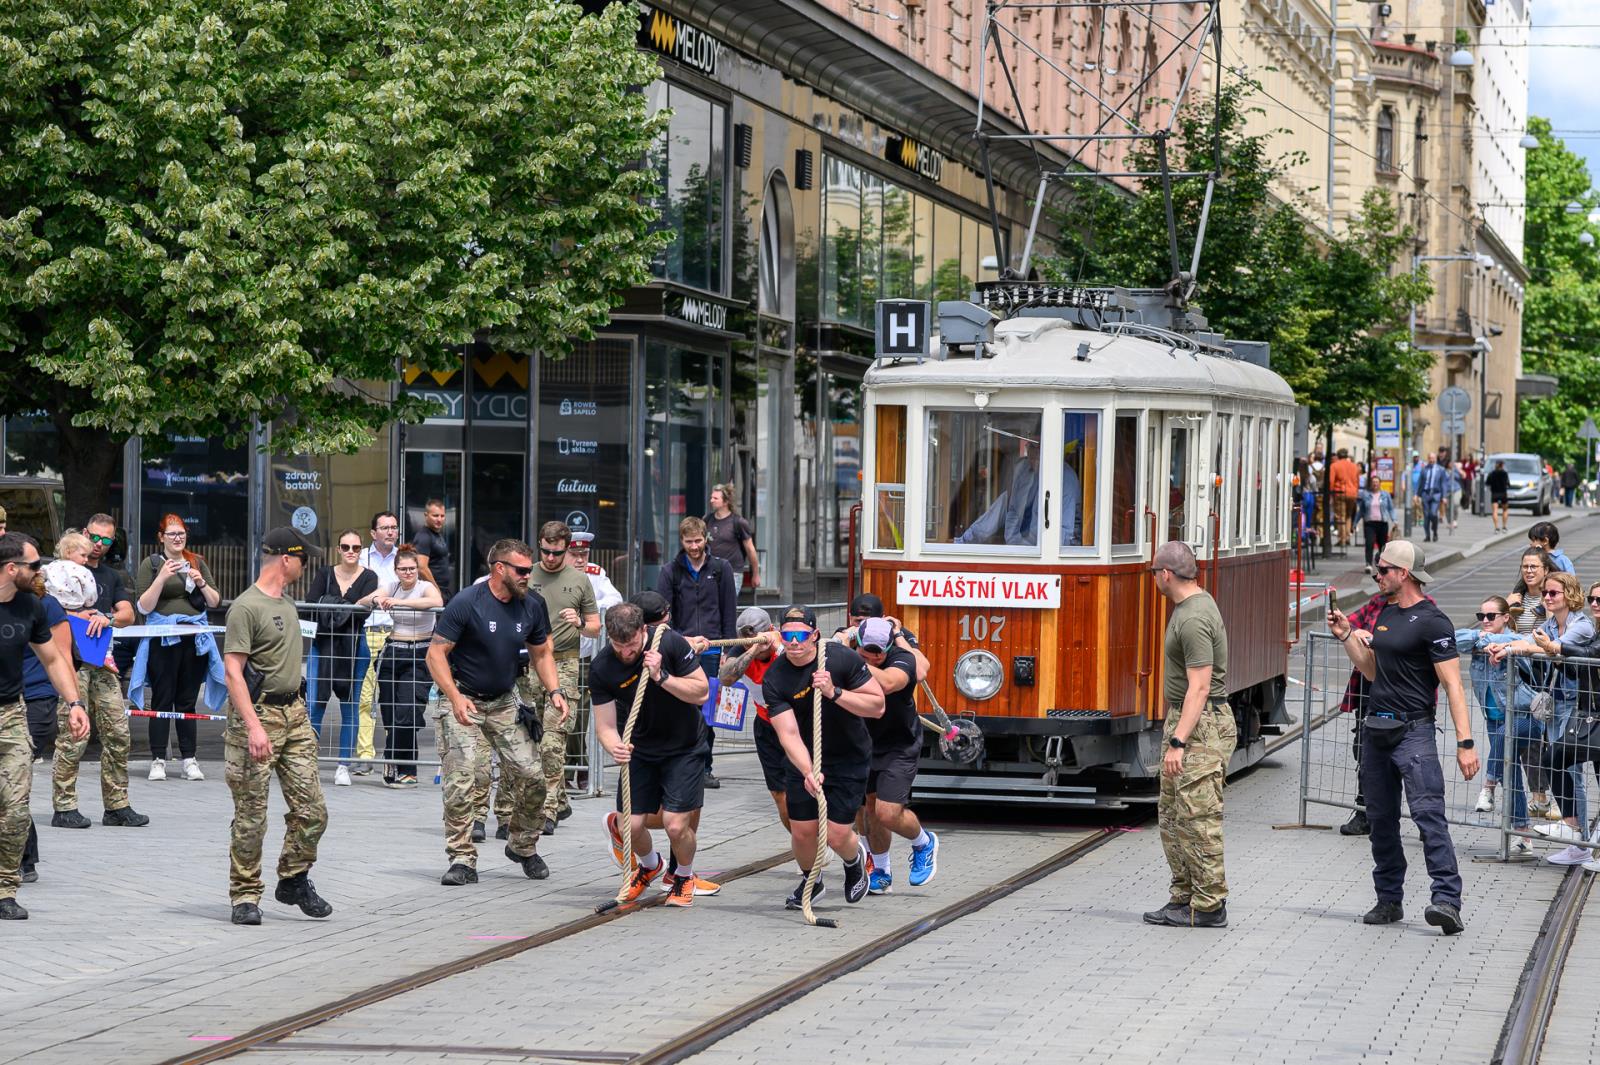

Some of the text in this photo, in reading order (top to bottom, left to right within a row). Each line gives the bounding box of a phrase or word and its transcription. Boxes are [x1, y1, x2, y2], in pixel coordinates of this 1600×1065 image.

[675, 19, 721, 76] MELODY
[916, 142, 945, 182] MELODY
[698, 300, 727, 330] MELODY
[889, 312, 916, 348] H
[909, 575, 1049, 600] ZVLÁŠTNÍ VLAK
[958, 614, 1006, 642] 107
